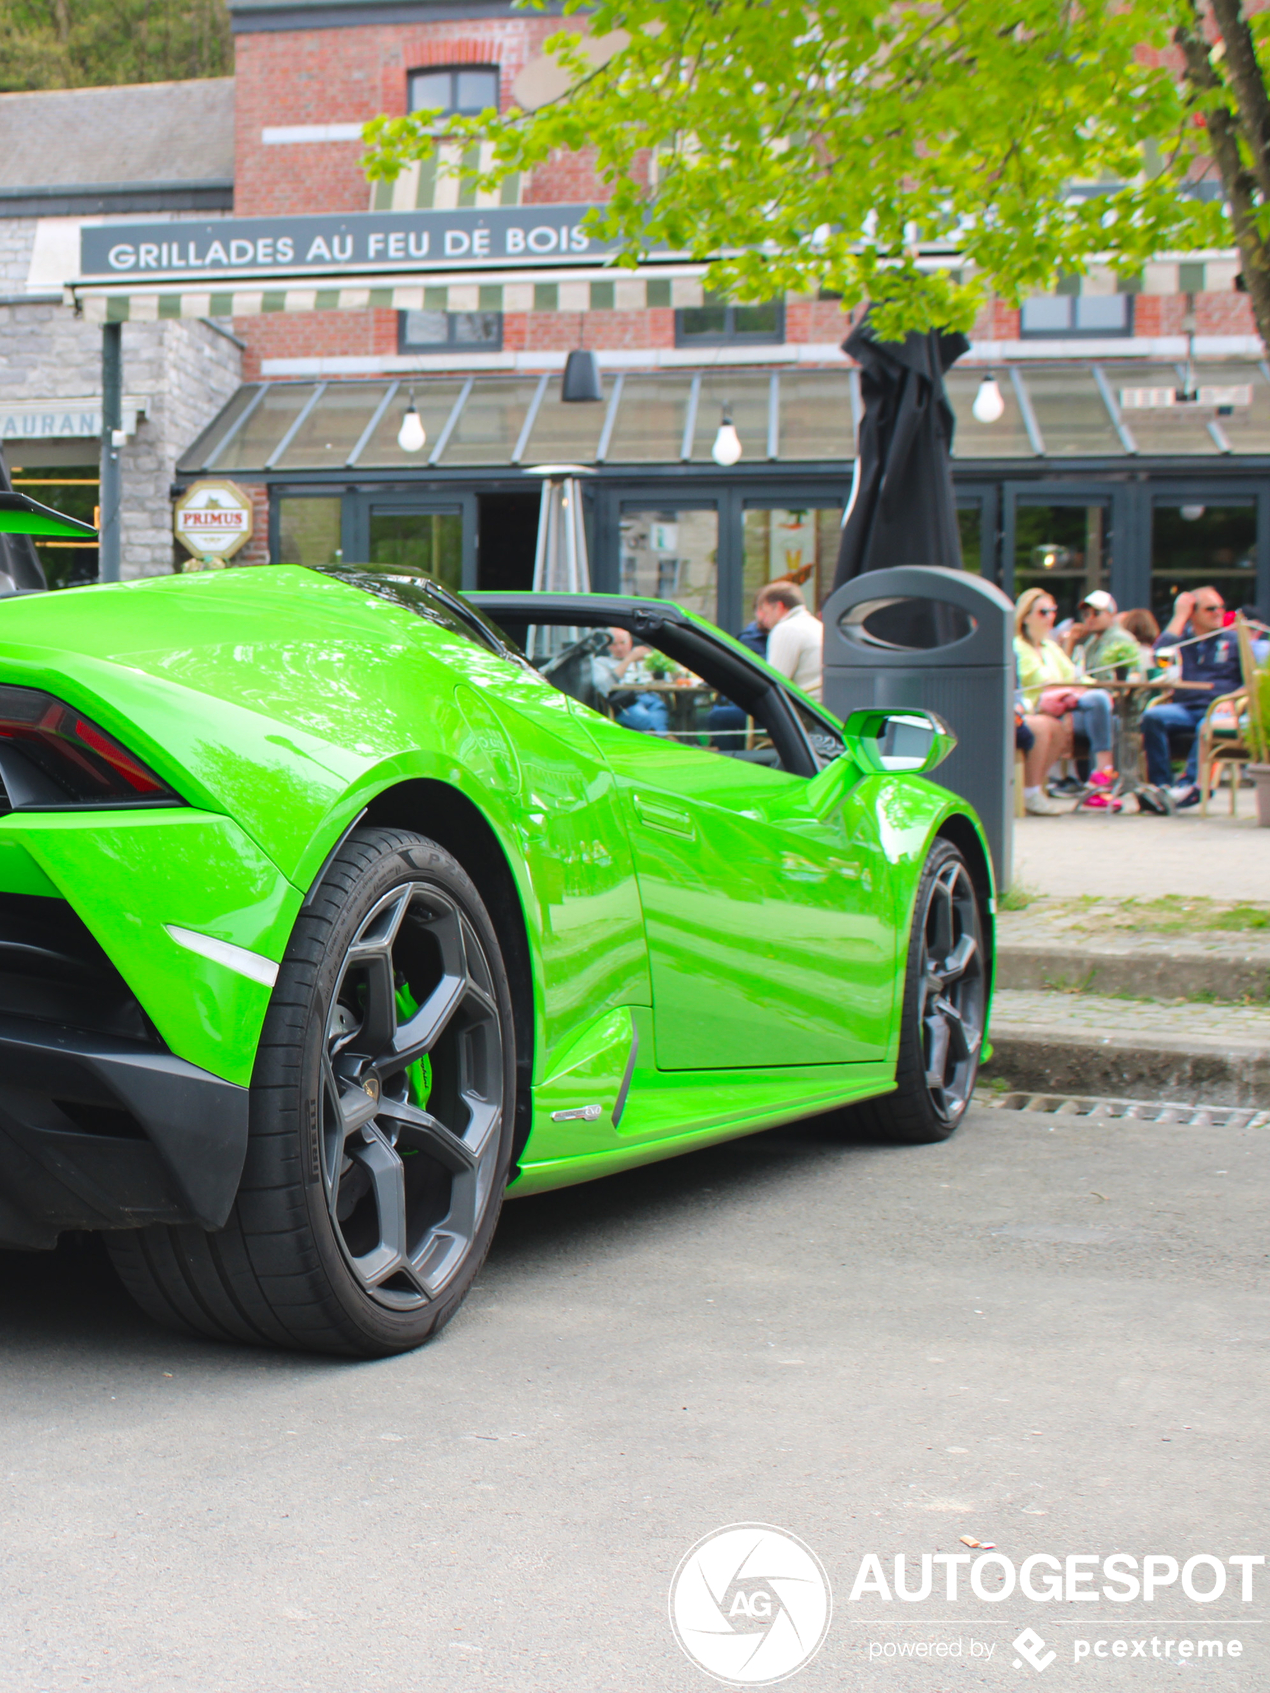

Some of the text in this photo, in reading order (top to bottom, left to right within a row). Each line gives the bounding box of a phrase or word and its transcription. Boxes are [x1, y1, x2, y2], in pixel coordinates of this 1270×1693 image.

[108, 224, 590, 271] GRILLADES AU FEU DE BOIS
[183, 512, 243, 525] PRIMUS
